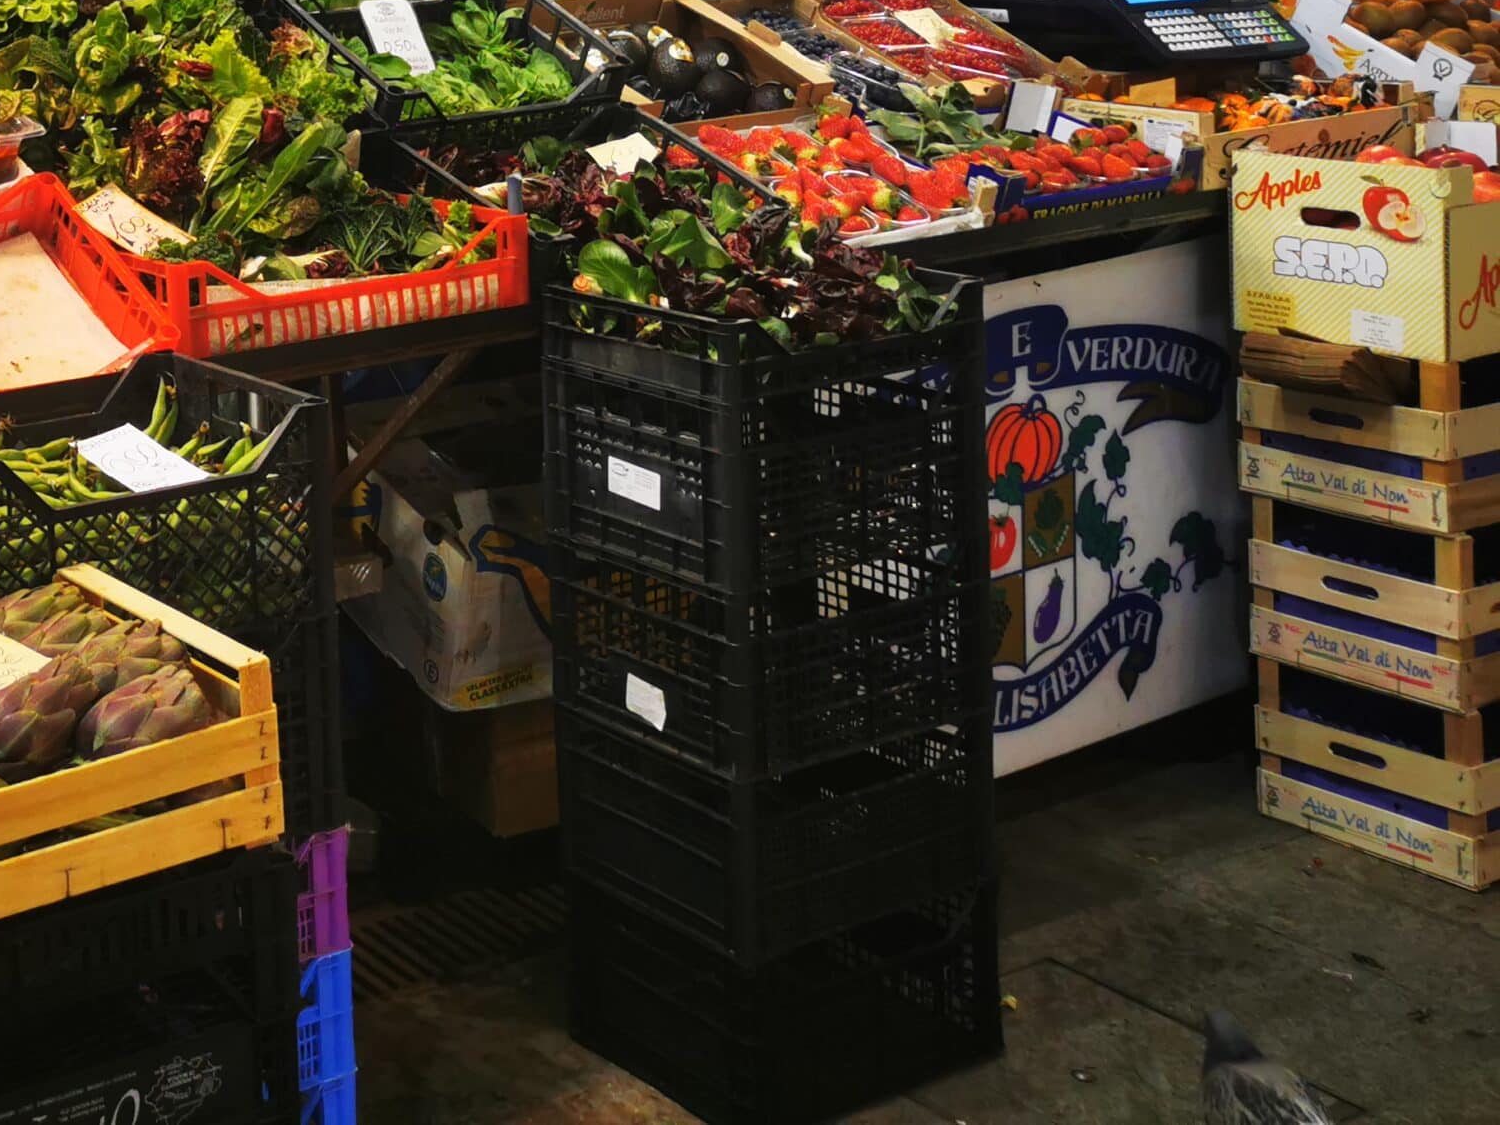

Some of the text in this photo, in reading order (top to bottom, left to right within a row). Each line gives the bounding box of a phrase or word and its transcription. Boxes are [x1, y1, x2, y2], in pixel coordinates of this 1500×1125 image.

[1235, 168, 1323, 212] Apples
[1457, 253, 1500, 331] Ap
[1012, 321, 1033, 358] E
[1066, 335, 1221, 391] VERDURA
[1281, 463, 1409, 505] Alta Val di Non
[1303, 630, 1433, 680] Alta Val di Non
[1302, 796, 1433, 854] Alta Val di Non
